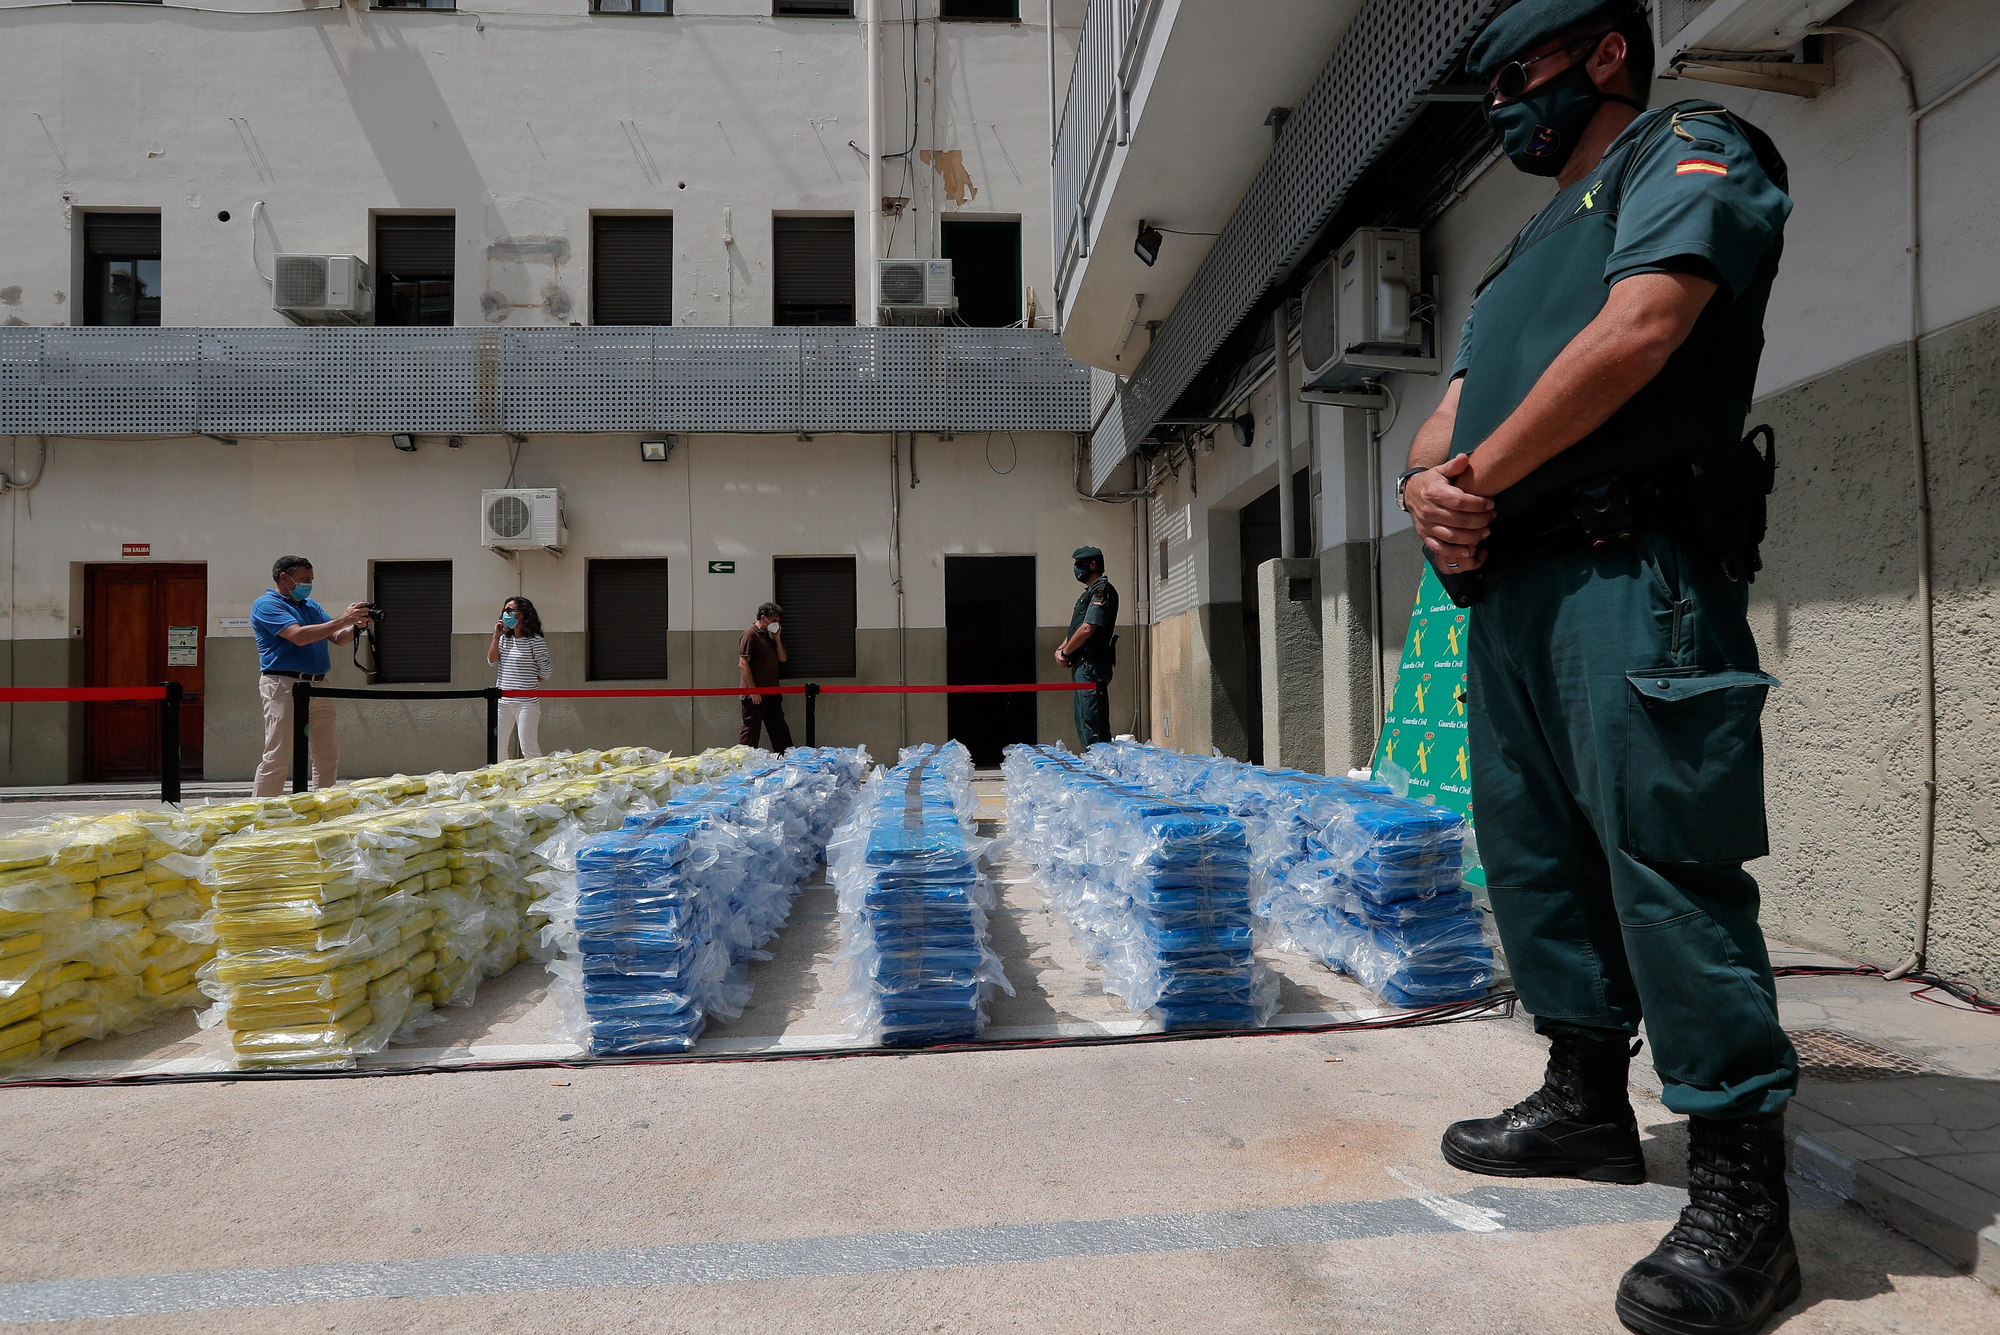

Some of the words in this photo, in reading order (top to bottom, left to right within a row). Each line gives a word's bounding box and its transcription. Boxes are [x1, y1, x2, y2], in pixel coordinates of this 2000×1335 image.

[1430, 604, 1446, 613] Guardia
[1434, 660, 1451, 668] Guardia
[1452, 660, 1463, 668] Civil
[1402, 717, 1417, 725] Guardia
[1438, 719, 1456, 728] Guardia
[1456, 721, 1468, 729] Civil
[1420, 778, 1430, 787] Civil
[1440, 782, 1459, 793] Guardia
[1459, 785, 1471, 795] Civil
